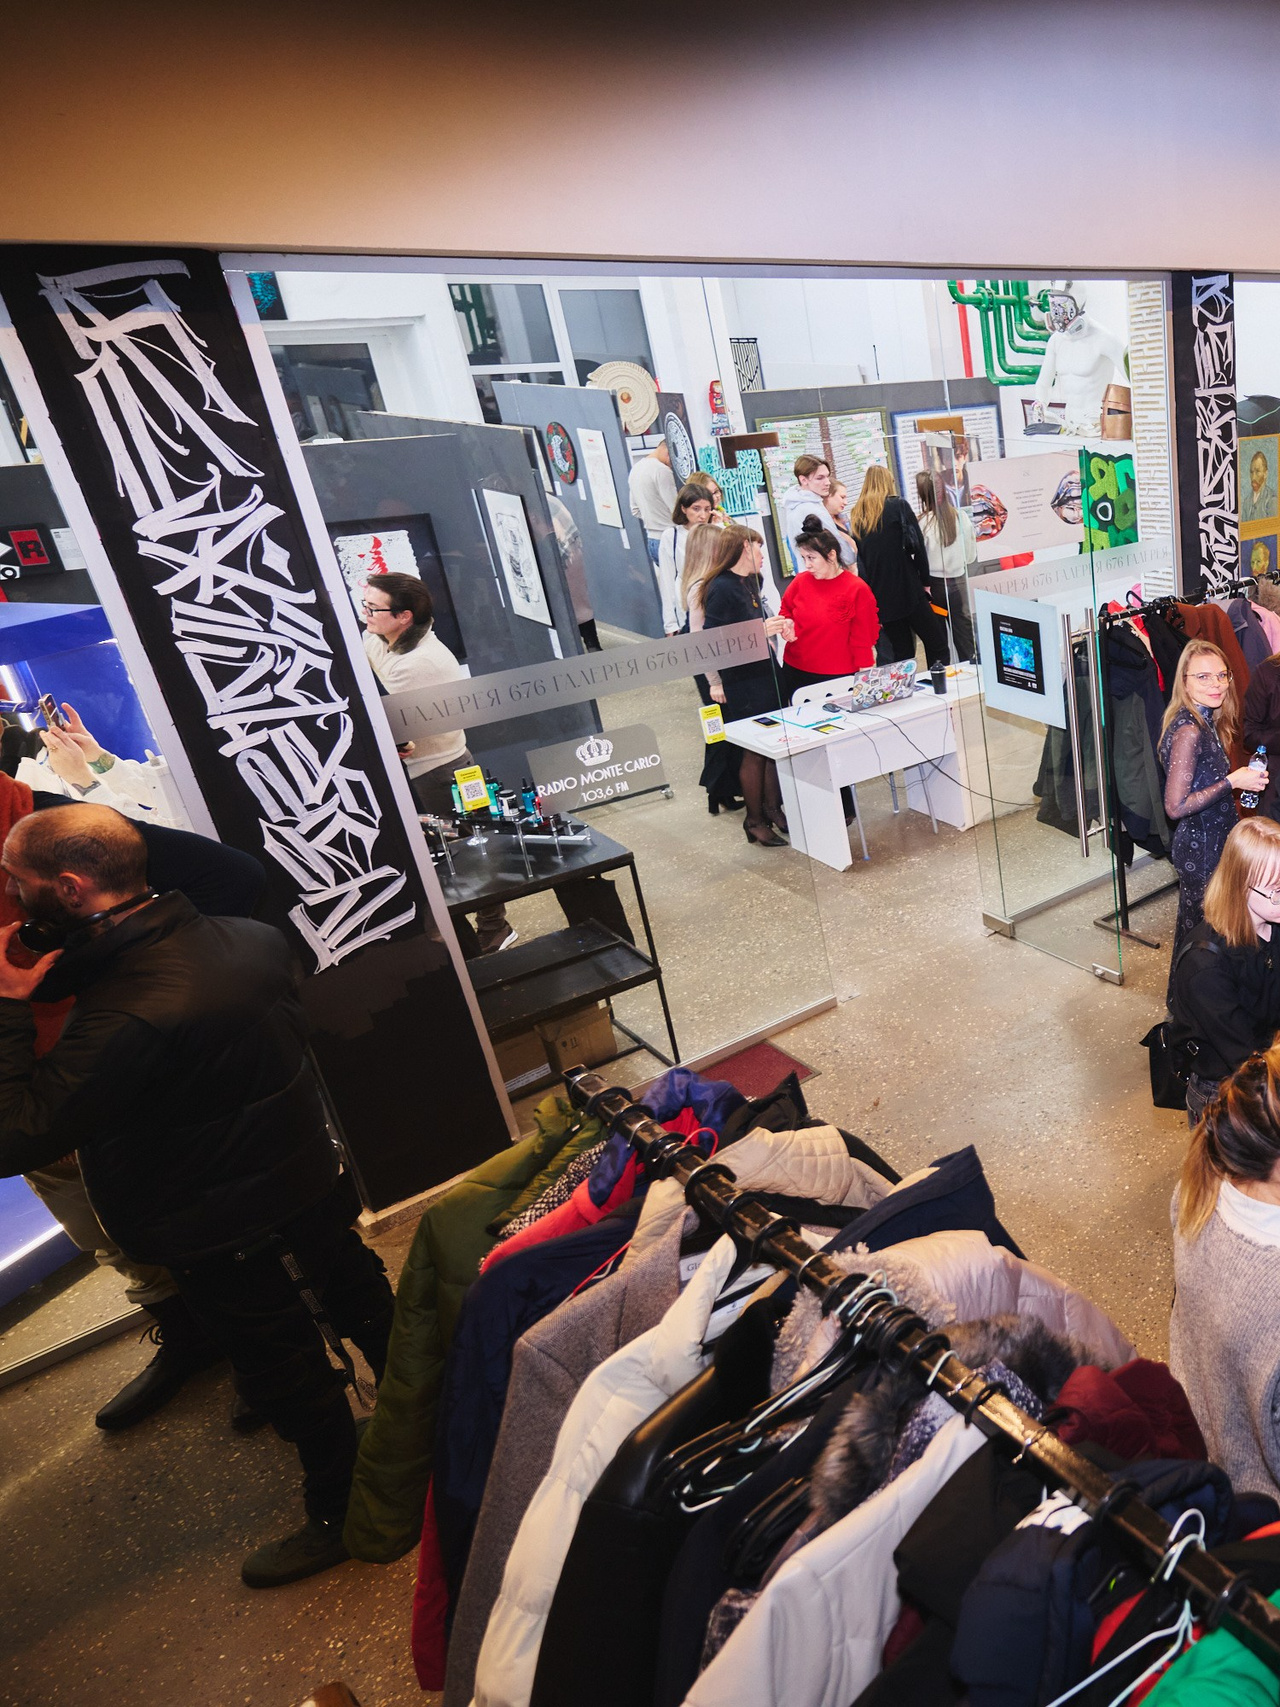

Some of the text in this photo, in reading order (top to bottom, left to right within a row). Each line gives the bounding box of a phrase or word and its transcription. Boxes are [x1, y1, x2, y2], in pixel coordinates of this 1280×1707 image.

[1032, 572, 1053, 587] 676
[1106, 556, 1124, 571] 676
[399, 634, 760, 727] ГАЛЕРЕЯ 676 ГАЛЕРЕЯ 676 ГАЛЕРЕЯ
[536, 754, 661, 798] RADIO MONTE CARLO
[581, 780, 630, 803] 103,6 FM
